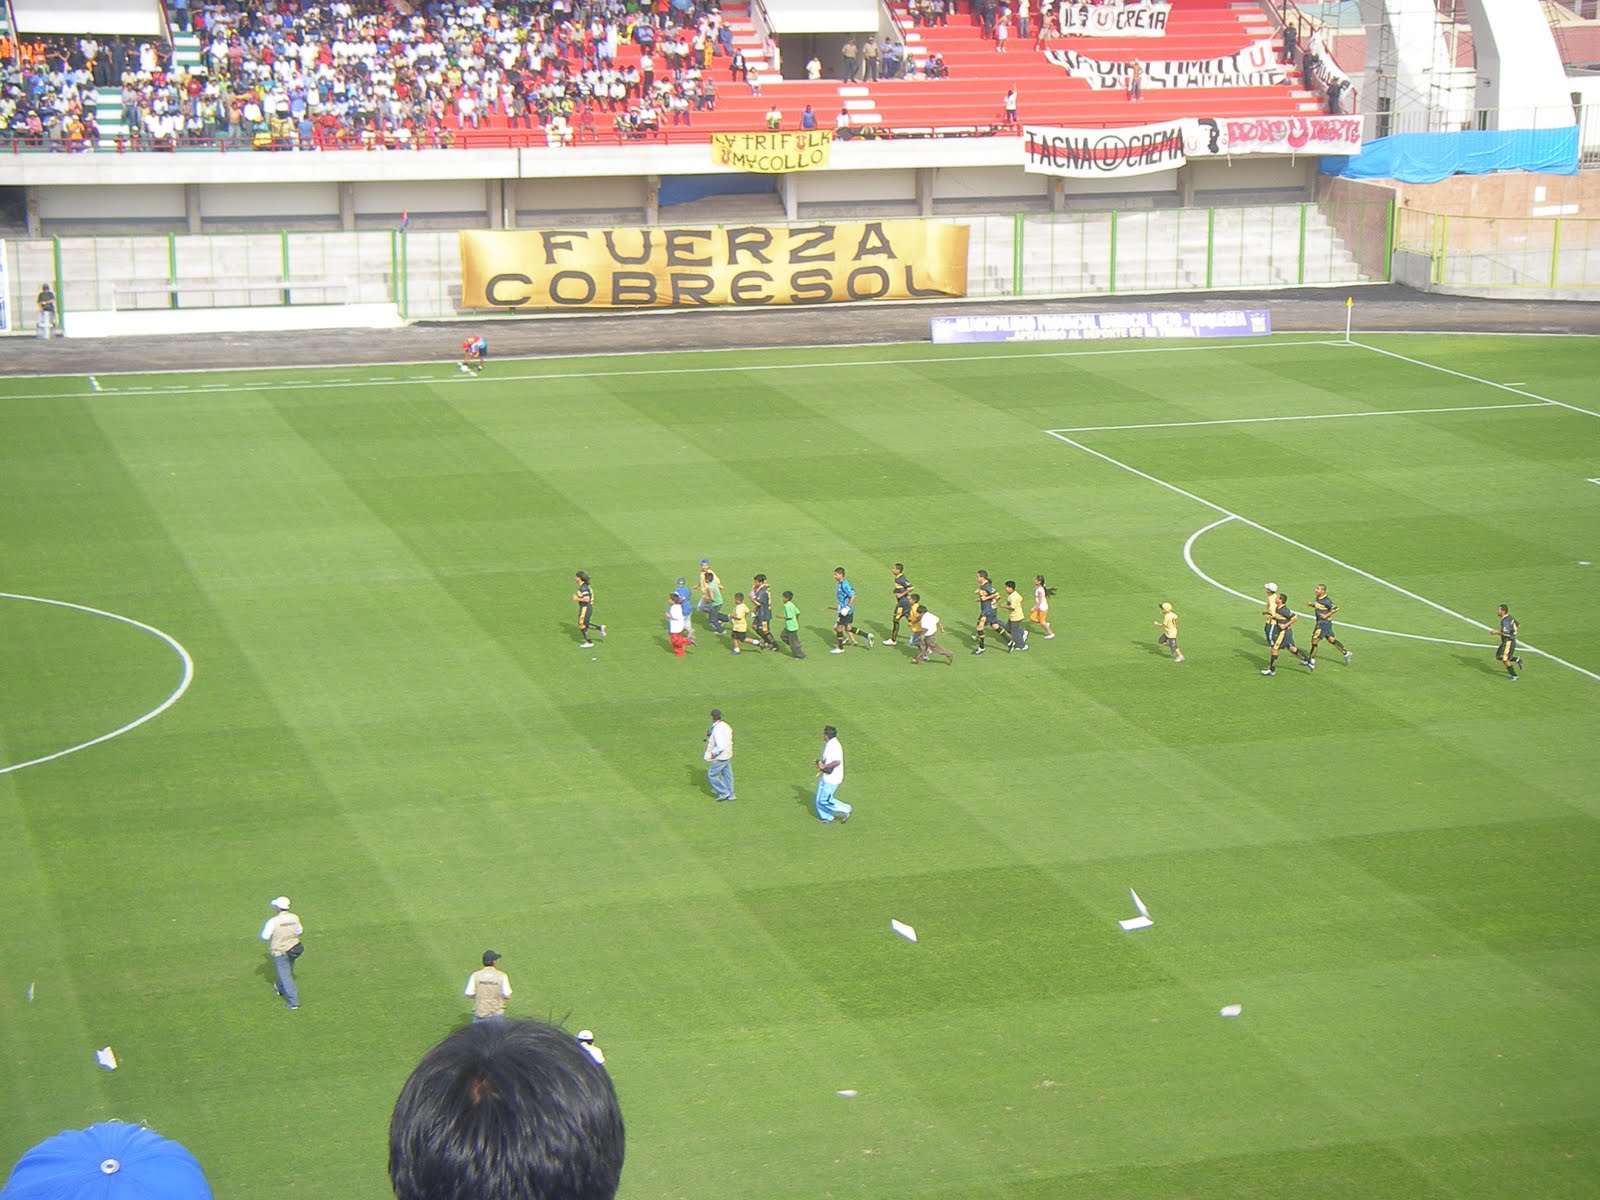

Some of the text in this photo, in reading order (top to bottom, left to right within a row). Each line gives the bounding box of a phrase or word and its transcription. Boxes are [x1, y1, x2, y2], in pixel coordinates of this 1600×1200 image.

[1025, 130, 1092, 170] TACNA
[1127, 126, 1185, 168] CREMA
[539, 222, 897, 267] FUERZA
[485, 264, 960, 306] COBRESOL
